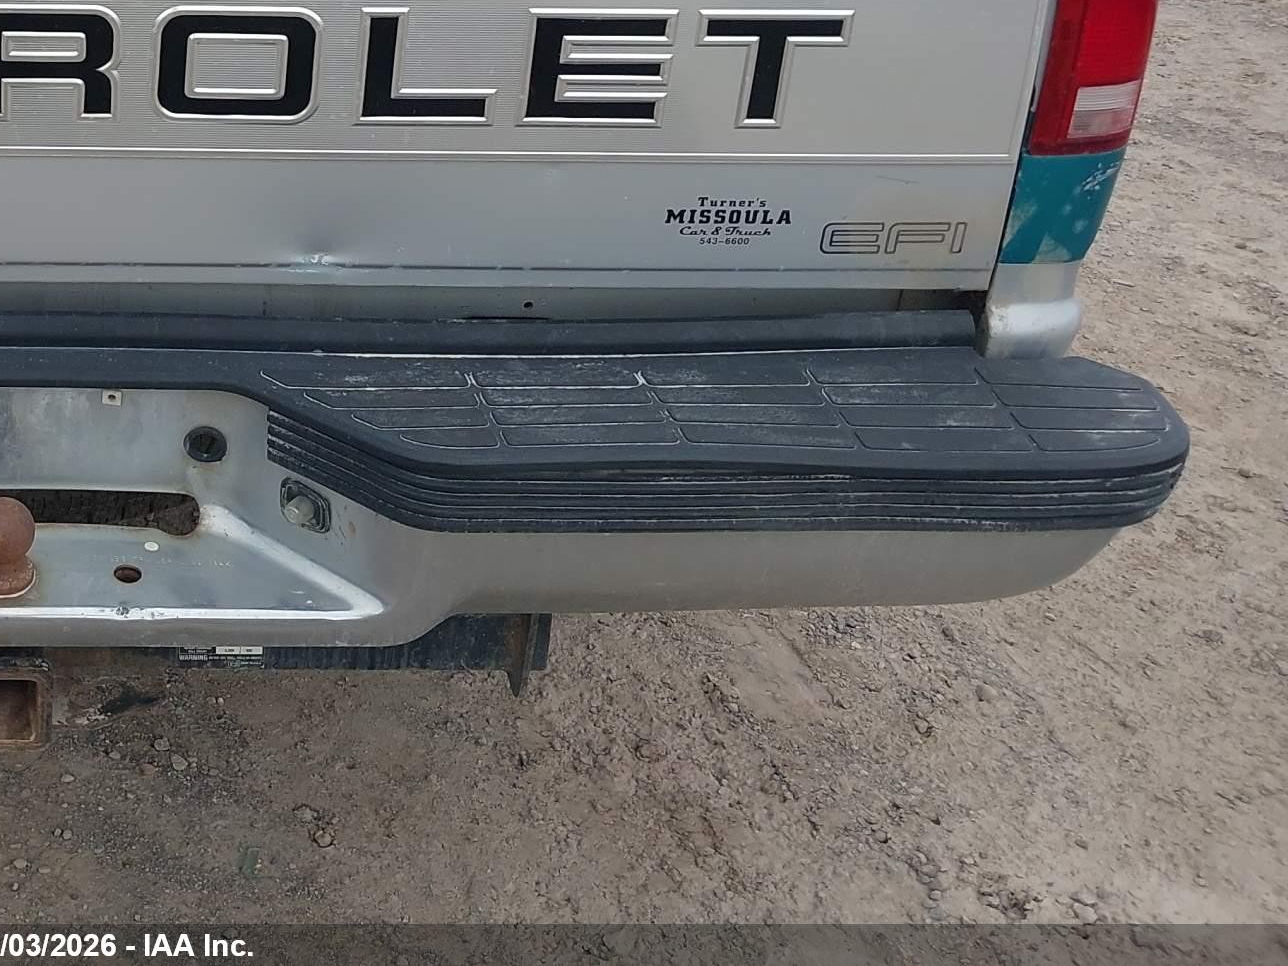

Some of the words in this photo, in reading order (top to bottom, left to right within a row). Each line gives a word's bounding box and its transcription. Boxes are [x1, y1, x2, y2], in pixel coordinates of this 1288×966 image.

[697, 197, 767, 208] Turner's
[665, 209, 792, 225] MISSOULA
[679, 226, 708, 236] Car
[710, 226, 722, 236] &
[725, 227, 772, 236] Truck
[698, 237, 750, 245] 543-6600
[819, 222, 968, 255] EFI
